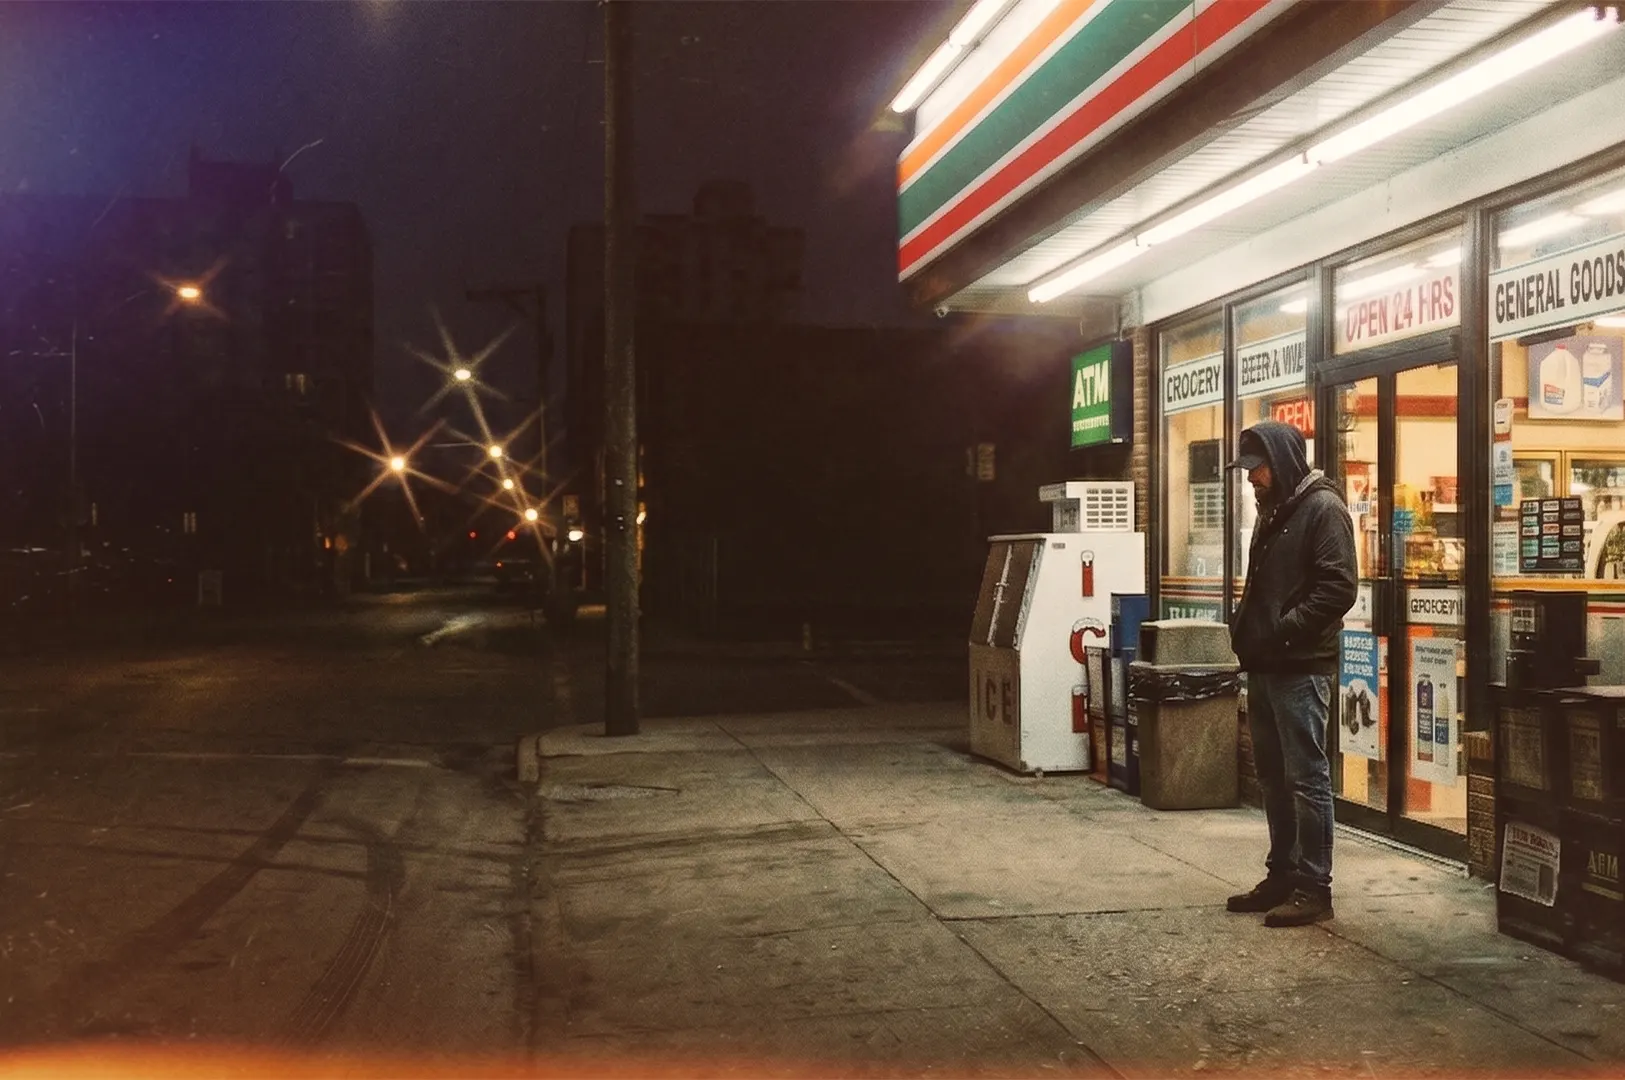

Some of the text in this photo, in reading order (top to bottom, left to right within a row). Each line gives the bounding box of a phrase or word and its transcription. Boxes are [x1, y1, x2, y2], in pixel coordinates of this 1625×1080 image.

[1346, 276, 1454, 342] OPEN 24 HRS
[1495, 249, 1625, 324] GENERAL GOODS
[1072, 359, 1109, 409] ATM
[976, 668, 1013, 728] ICE
